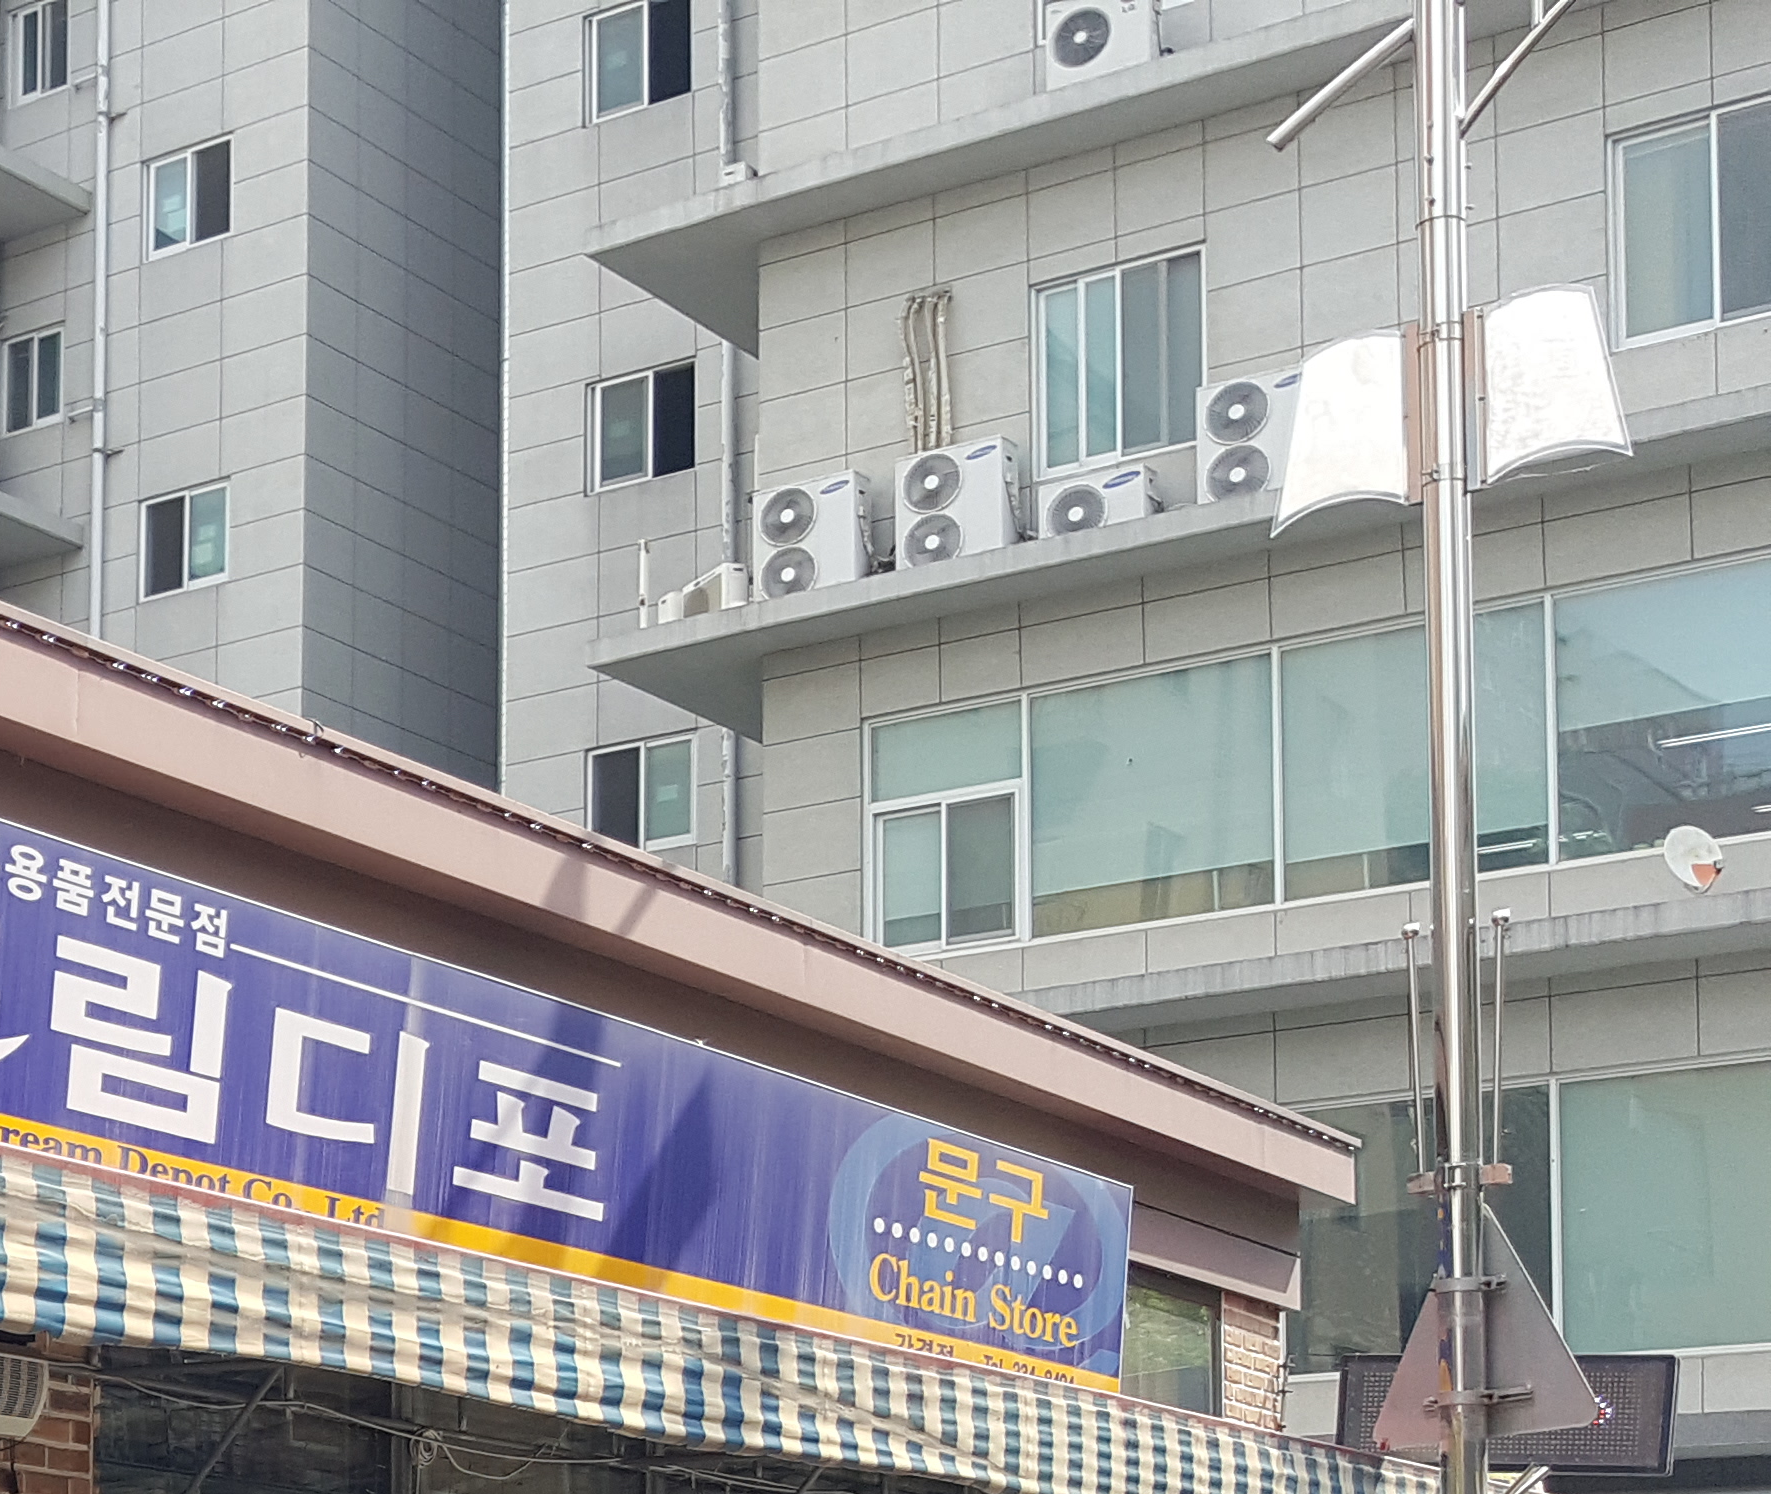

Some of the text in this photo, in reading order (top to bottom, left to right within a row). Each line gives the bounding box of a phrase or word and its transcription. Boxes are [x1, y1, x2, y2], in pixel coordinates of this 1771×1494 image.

[918, 1137, 1049, 1243] 문구
[869, 1252, 1078, 1349] Chain Store
